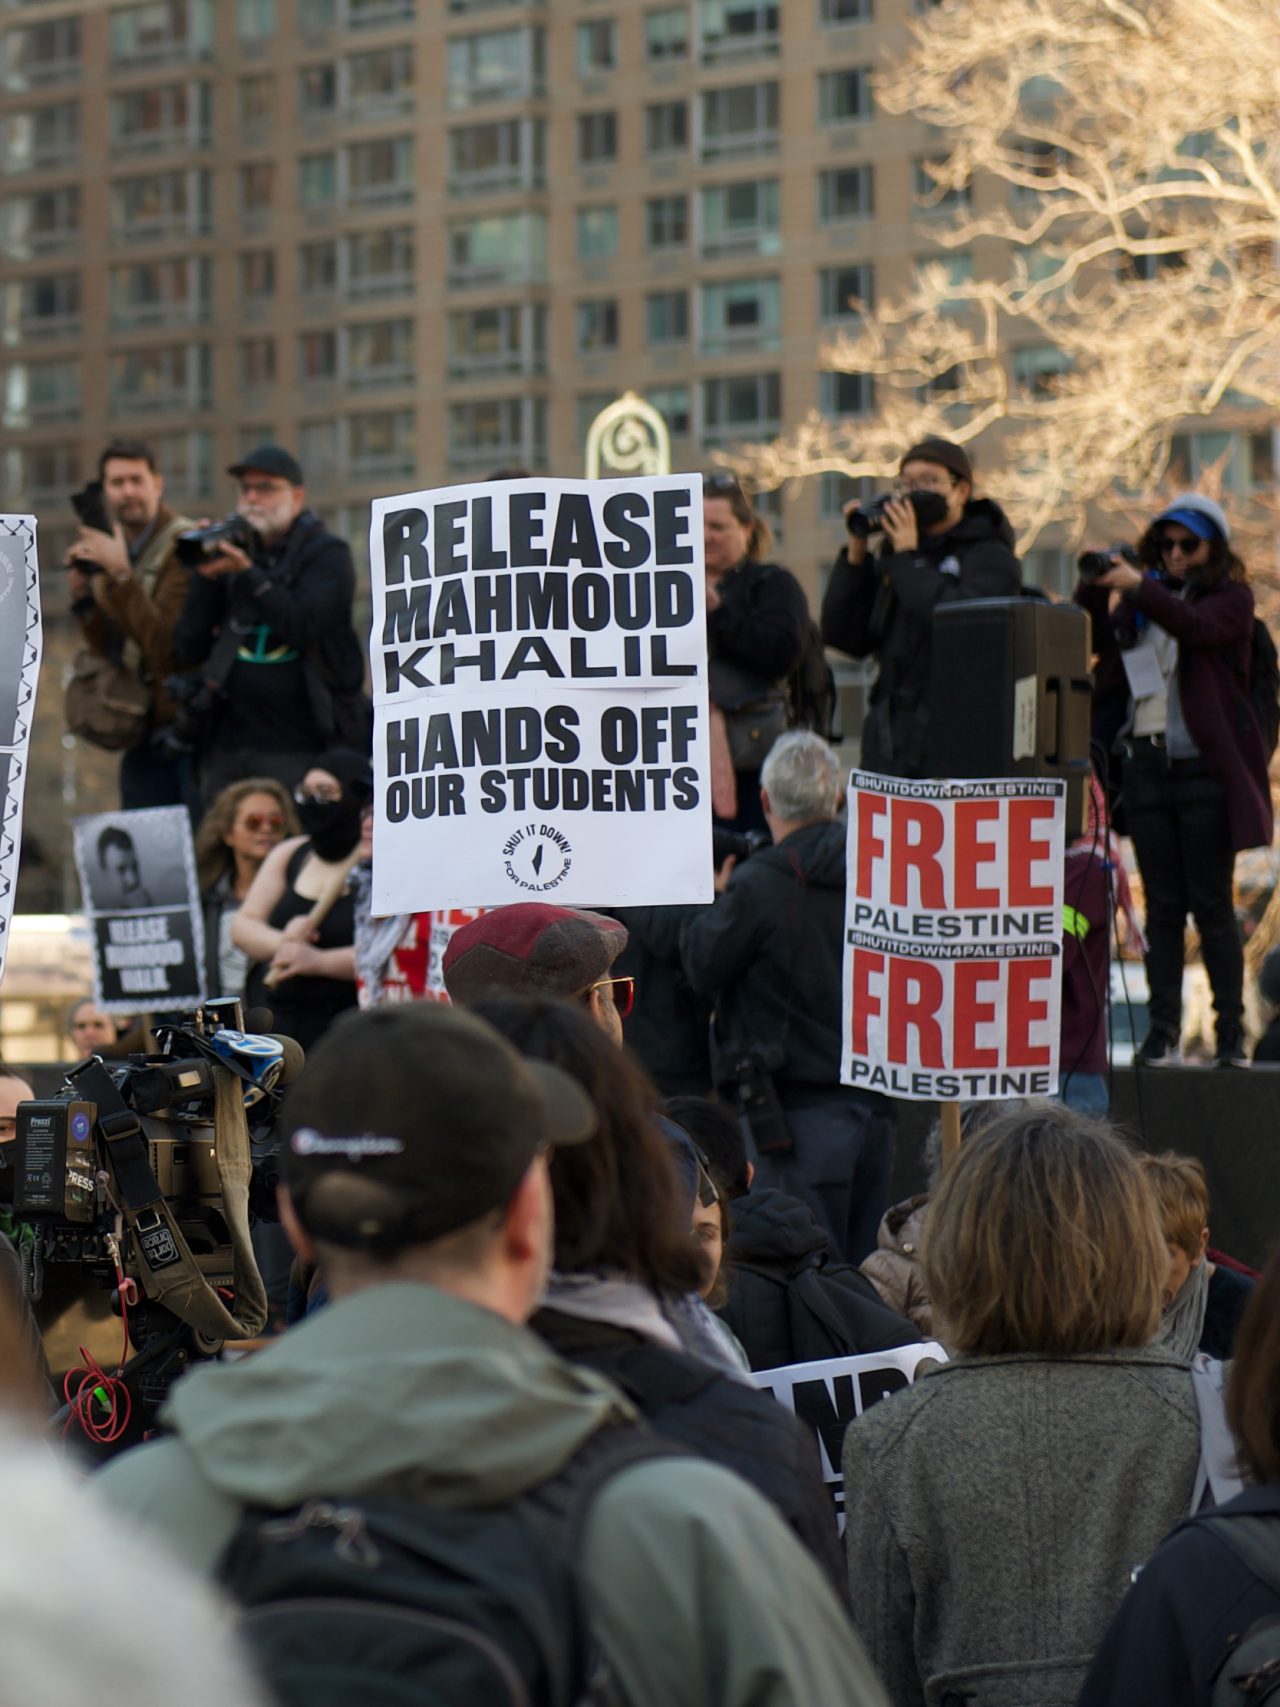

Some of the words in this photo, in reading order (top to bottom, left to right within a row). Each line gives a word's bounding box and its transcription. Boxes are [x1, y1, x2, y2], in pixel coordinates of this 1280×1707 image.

[383, 489, 694, 585] RELEASE
[382, 570, 694, 645] MAHMOUD
[384, 635, 697, 693] KHALIL
[387, 705, 580, 778] HANDS
[601, 705, 698, 765] OFF
[386, 773, 466, 823] OUR
[480, 767, 700, 814] STUDENTS
[502, 829, 524, 856] SHUT
[526, 824, 536, 836] IT
[540, 824, 572, 854] DOWN!
[856, 791, 1055, 911] FREE
[504, 860, 520, 884] FOR
[520, 858, 572, 891] PALESTINE
[854, 903, 1054, 938] PALESTINE
[852, 948, 1052, 1071] FREE
[851, 1060, 1050, 1097] PALESTINE
